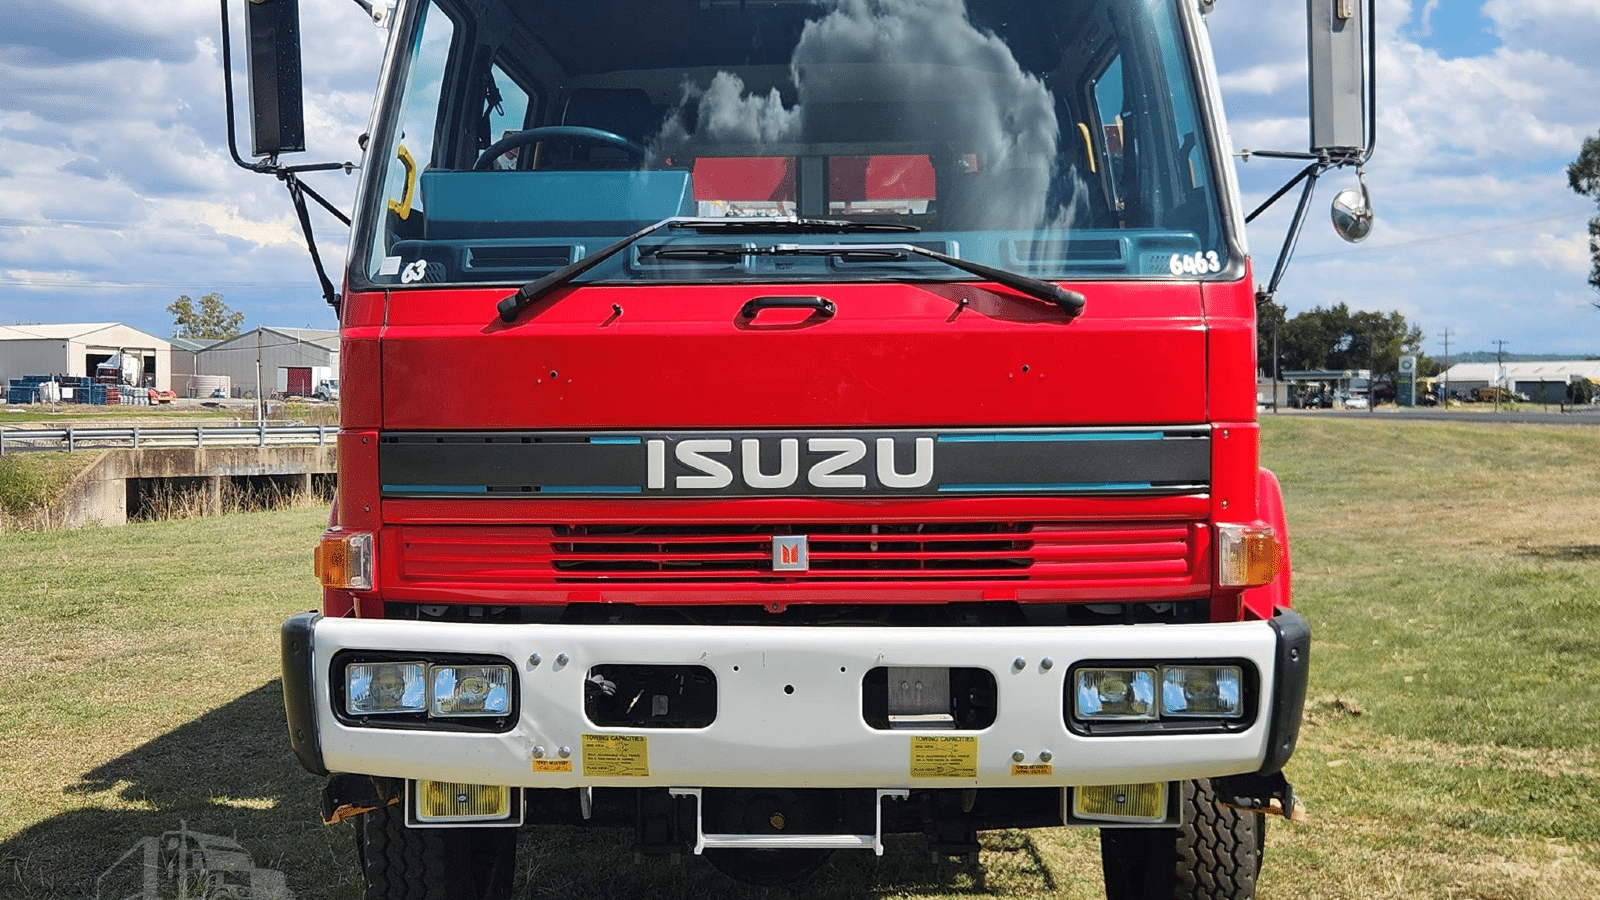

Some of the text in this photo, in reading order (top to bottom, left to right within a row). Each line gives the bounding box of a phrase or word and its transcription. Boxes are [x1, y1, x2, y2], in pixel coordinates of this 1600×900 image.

[401, 259, 427, 284] 63
[1169, 250, 1221, 276] 6463
[647, 437, 934, 489] ISUZU
